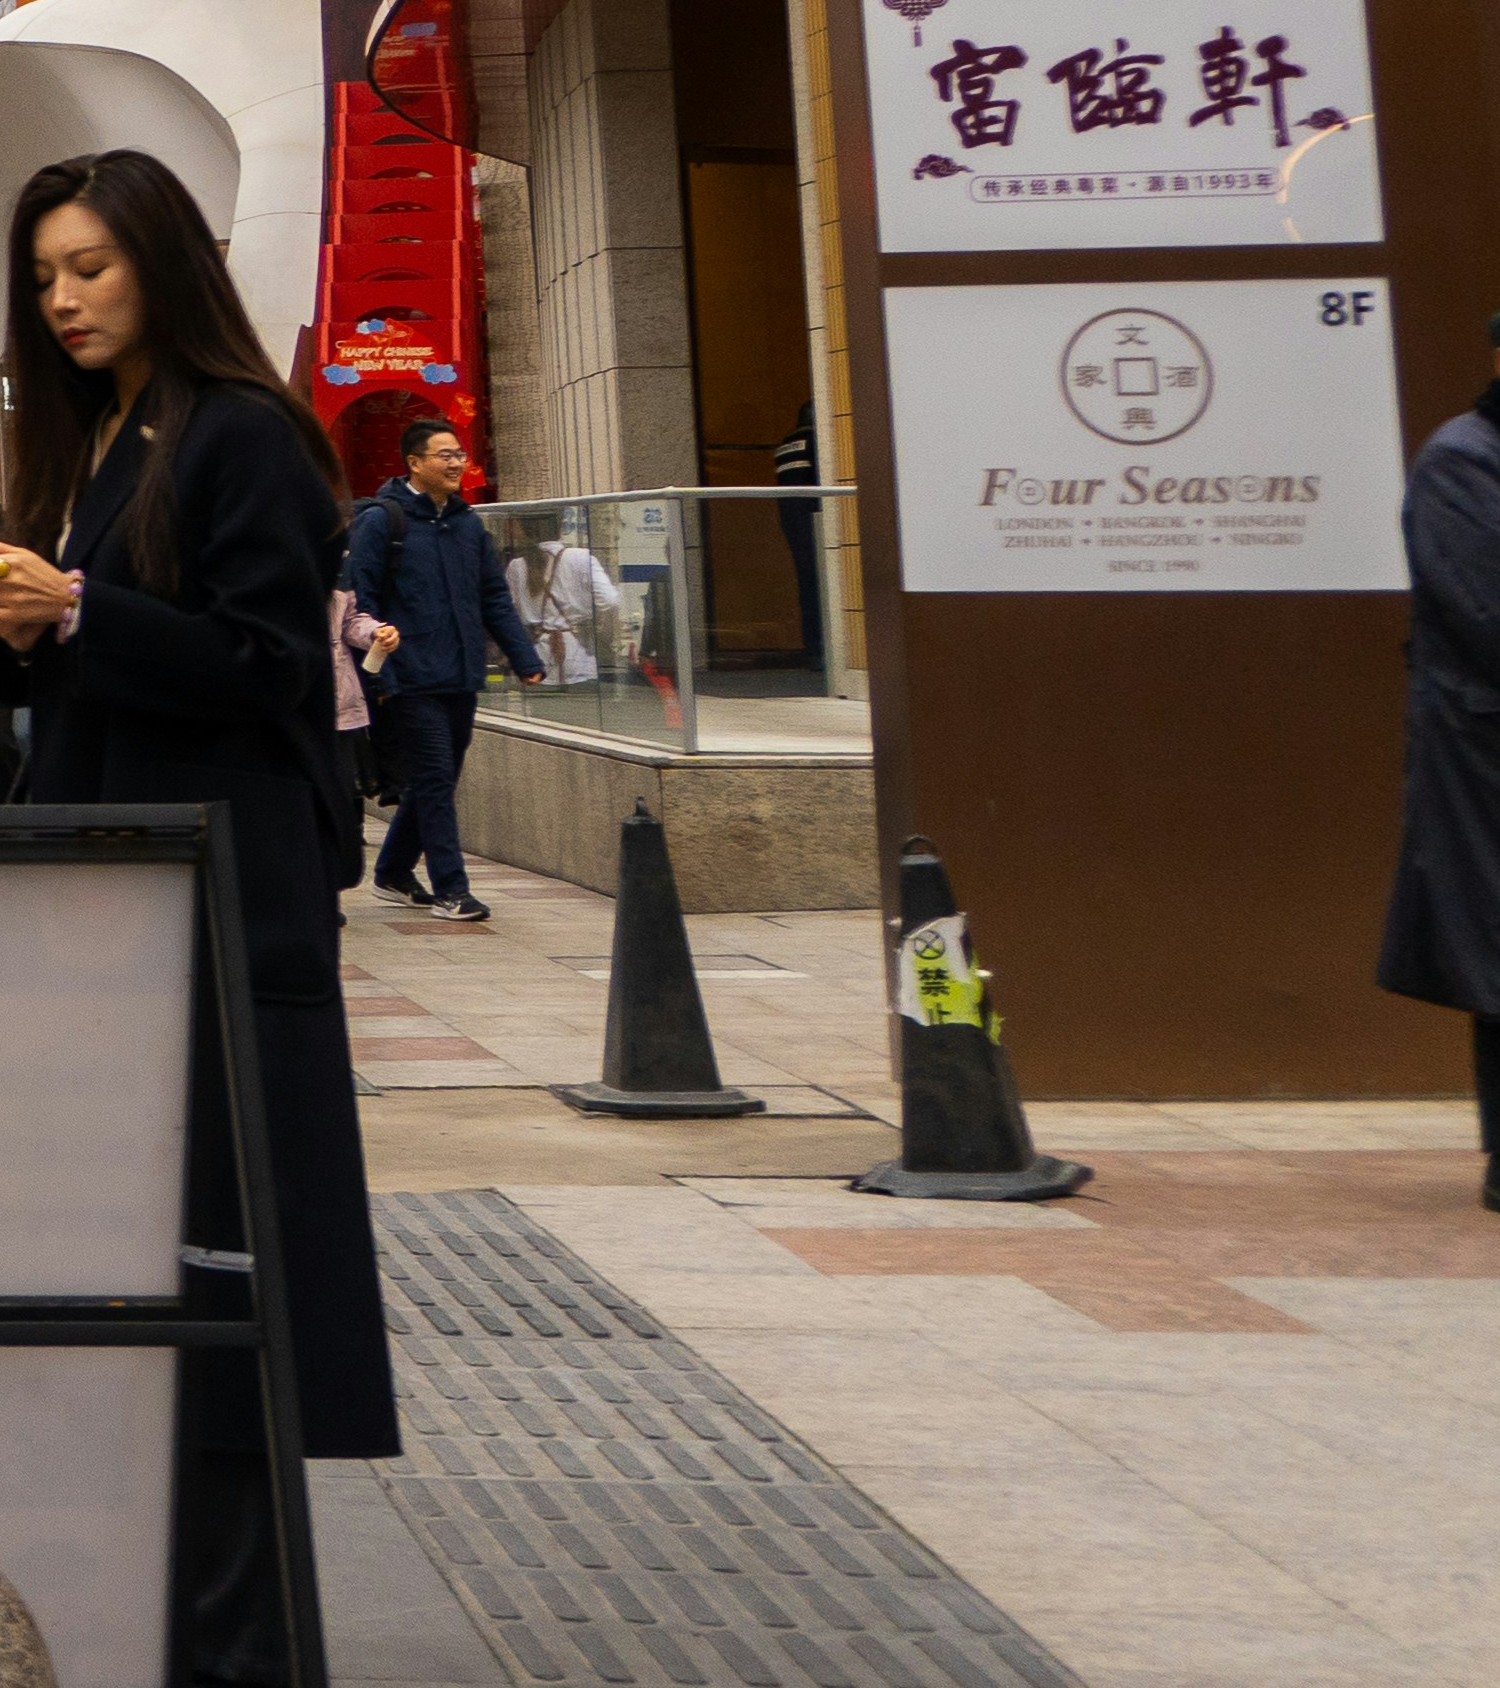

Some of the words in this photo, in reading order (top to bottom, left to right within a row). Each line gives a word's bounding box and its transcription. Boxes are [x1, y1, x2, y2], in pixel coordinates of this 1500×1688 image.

[1317, 291, 1375, 328] 8F
[1116, 323, 1148, 346] 文
[340, 347, 382, 358] HAPPY
[1073, 362, 1106, 389] 家
[977, 467, 1106, 507] Four
[1119, 465, 1322, 506] Seasons
[995, 517, 1074, 531] LONDON
[1101, 516, 1187, 529] BANGKOK
[1213, 514, 1307, 528] SHANGHAI
[1004, 535, 1073, 549] ZHUHAI
[1097, 534, 1200, 548] HANGZHOU
[1228, 533, 1305, 546] NINGBO
[1108, 560, 1156, 573] SINCE
